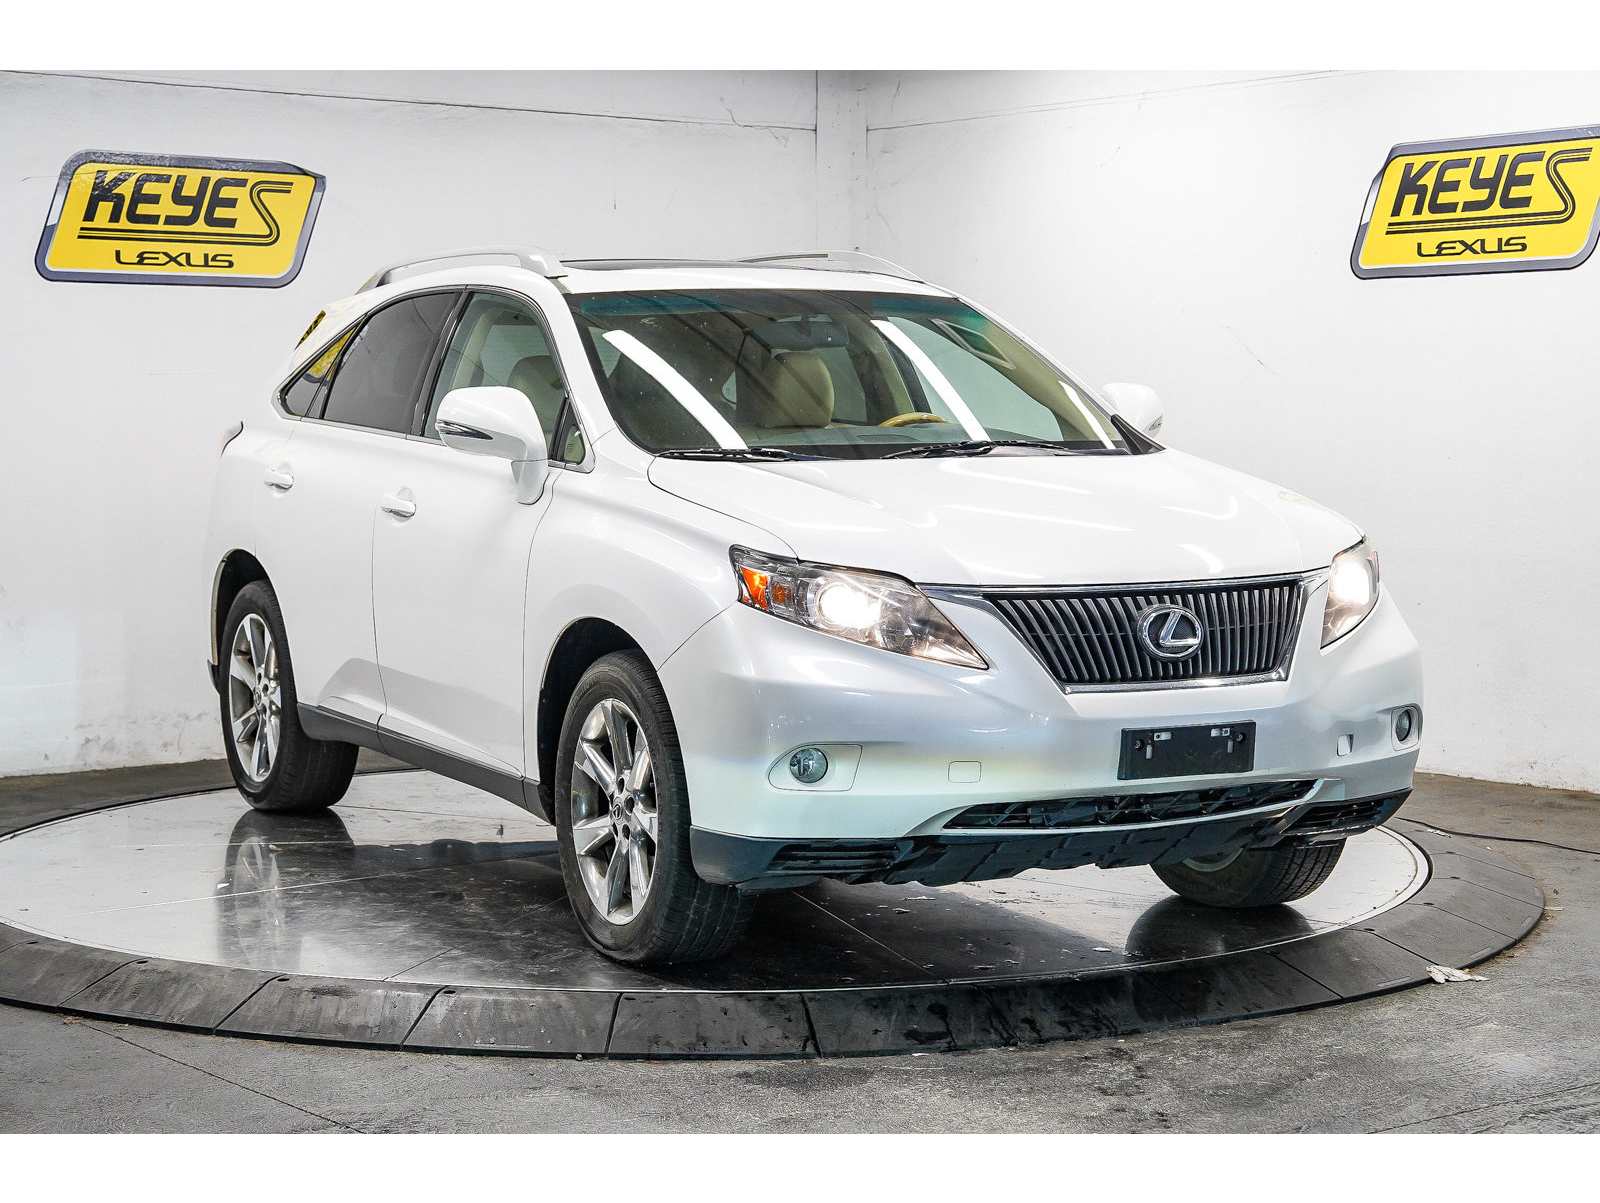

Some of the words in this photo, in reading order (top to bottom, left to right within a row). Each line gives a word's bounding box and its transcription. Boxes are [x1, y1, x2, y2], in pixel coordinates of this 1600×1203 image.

[79, 169, 294, 246] KEYES
[1386, 148, 1592, 233] KEYES
[114, 249, 234, 268] LEXUS
[1416, 236, 1528, 257] LEXUS
